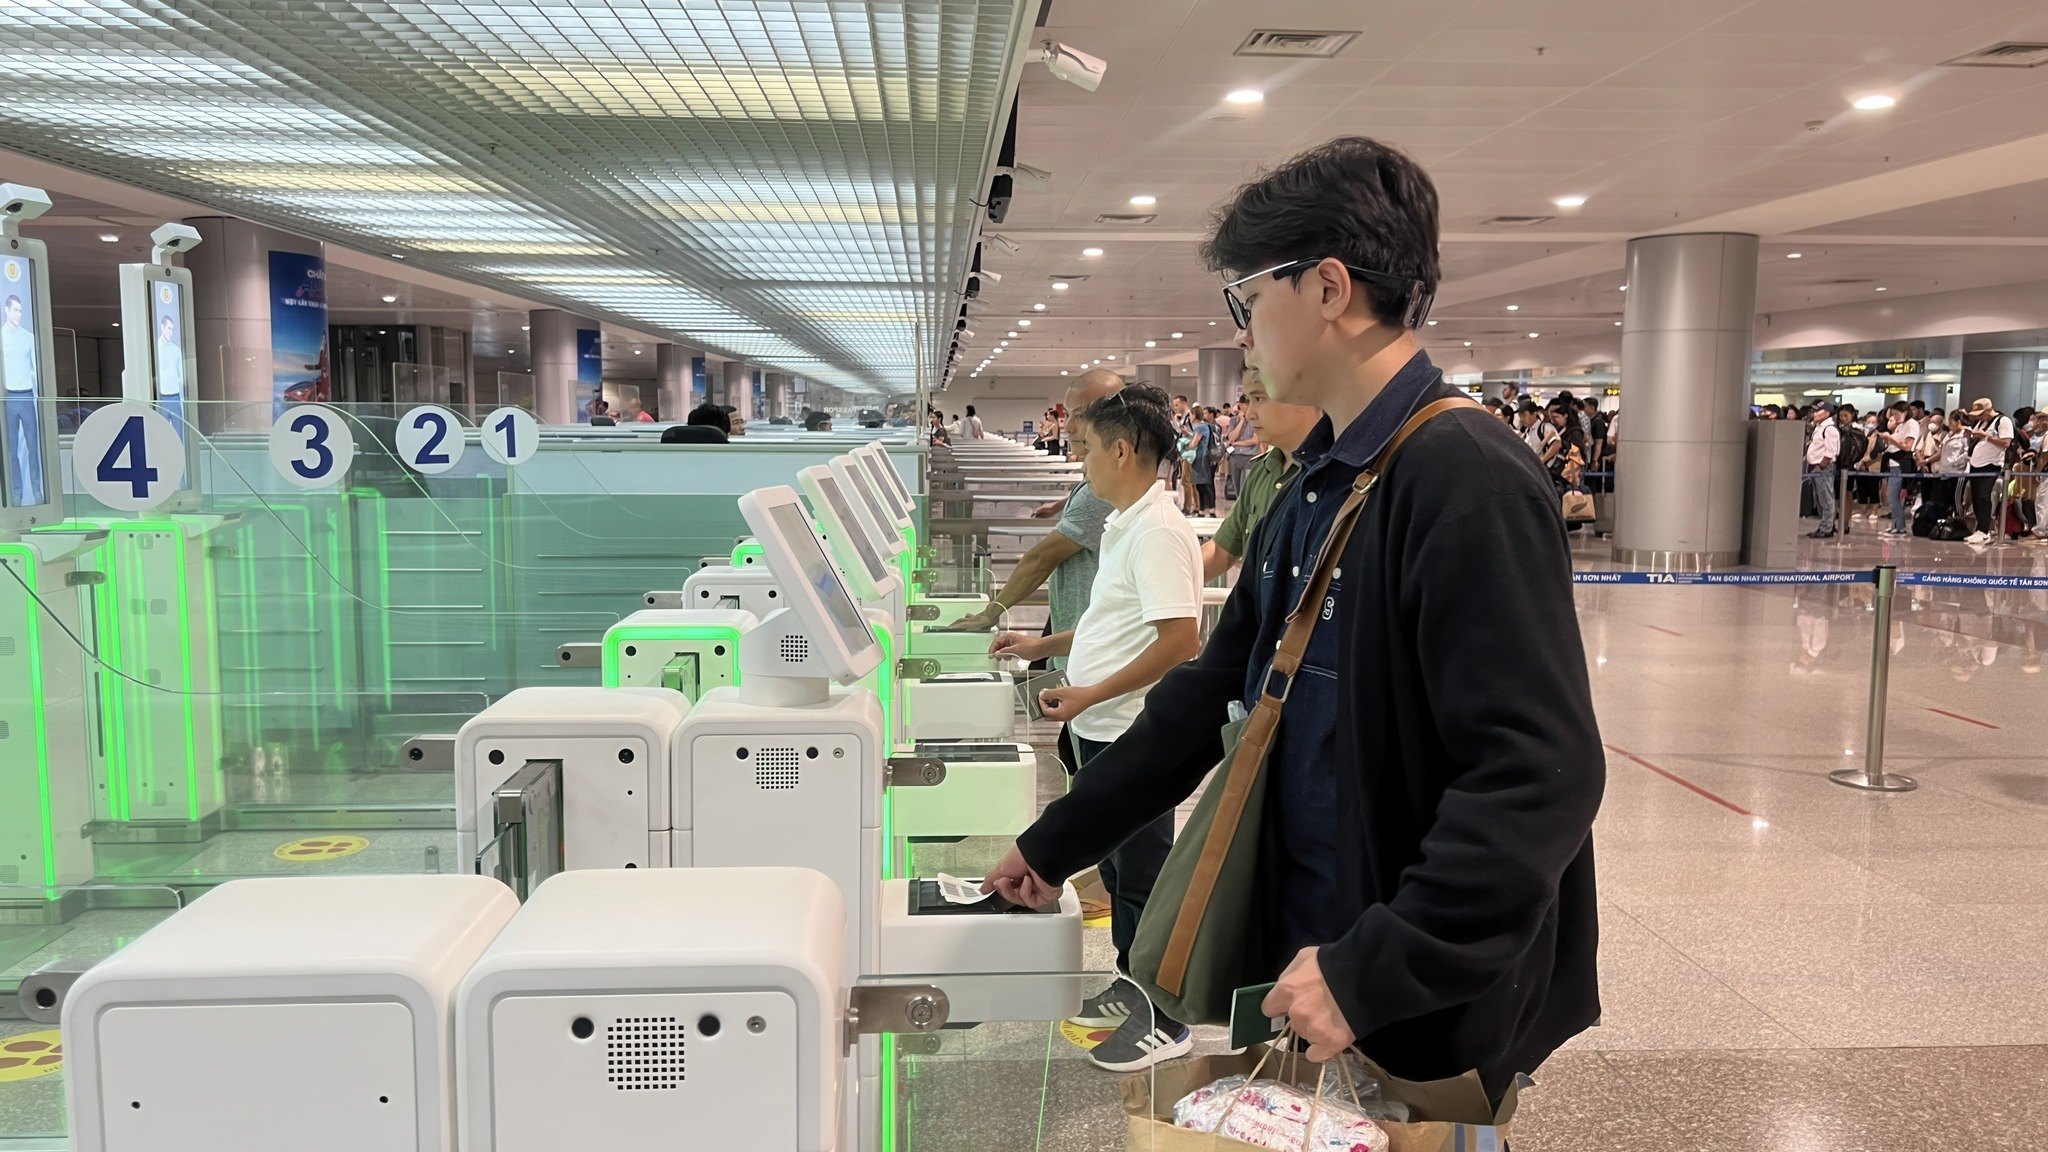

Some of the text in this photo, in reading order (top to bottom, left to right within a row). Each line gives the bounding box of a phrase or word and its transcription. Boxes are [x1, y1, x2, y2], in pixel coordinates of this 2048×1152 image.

[291, 415, 333, 478] 3
[413, 413, 449, 464] 2
[495, 415, 516, 457] 1
[97, 416, 158, 498] 4
[1646, 573, 1675, 583] TIA
[1762, 574, 1821, 582] INTERNATIONAL
[1822, 573, 1856, 581] AIRPORT
[1922, 574, 1941, 582] CẢNG
[1942, 575, 1961, 584] HÀNG
[1962, 576, 1987, 585] KHÔNG
[1988, 577, 2008, 585] QUỐC
[2009, 577, 2019, 586] TẾ
[1322, 597, 1335, 620] S
